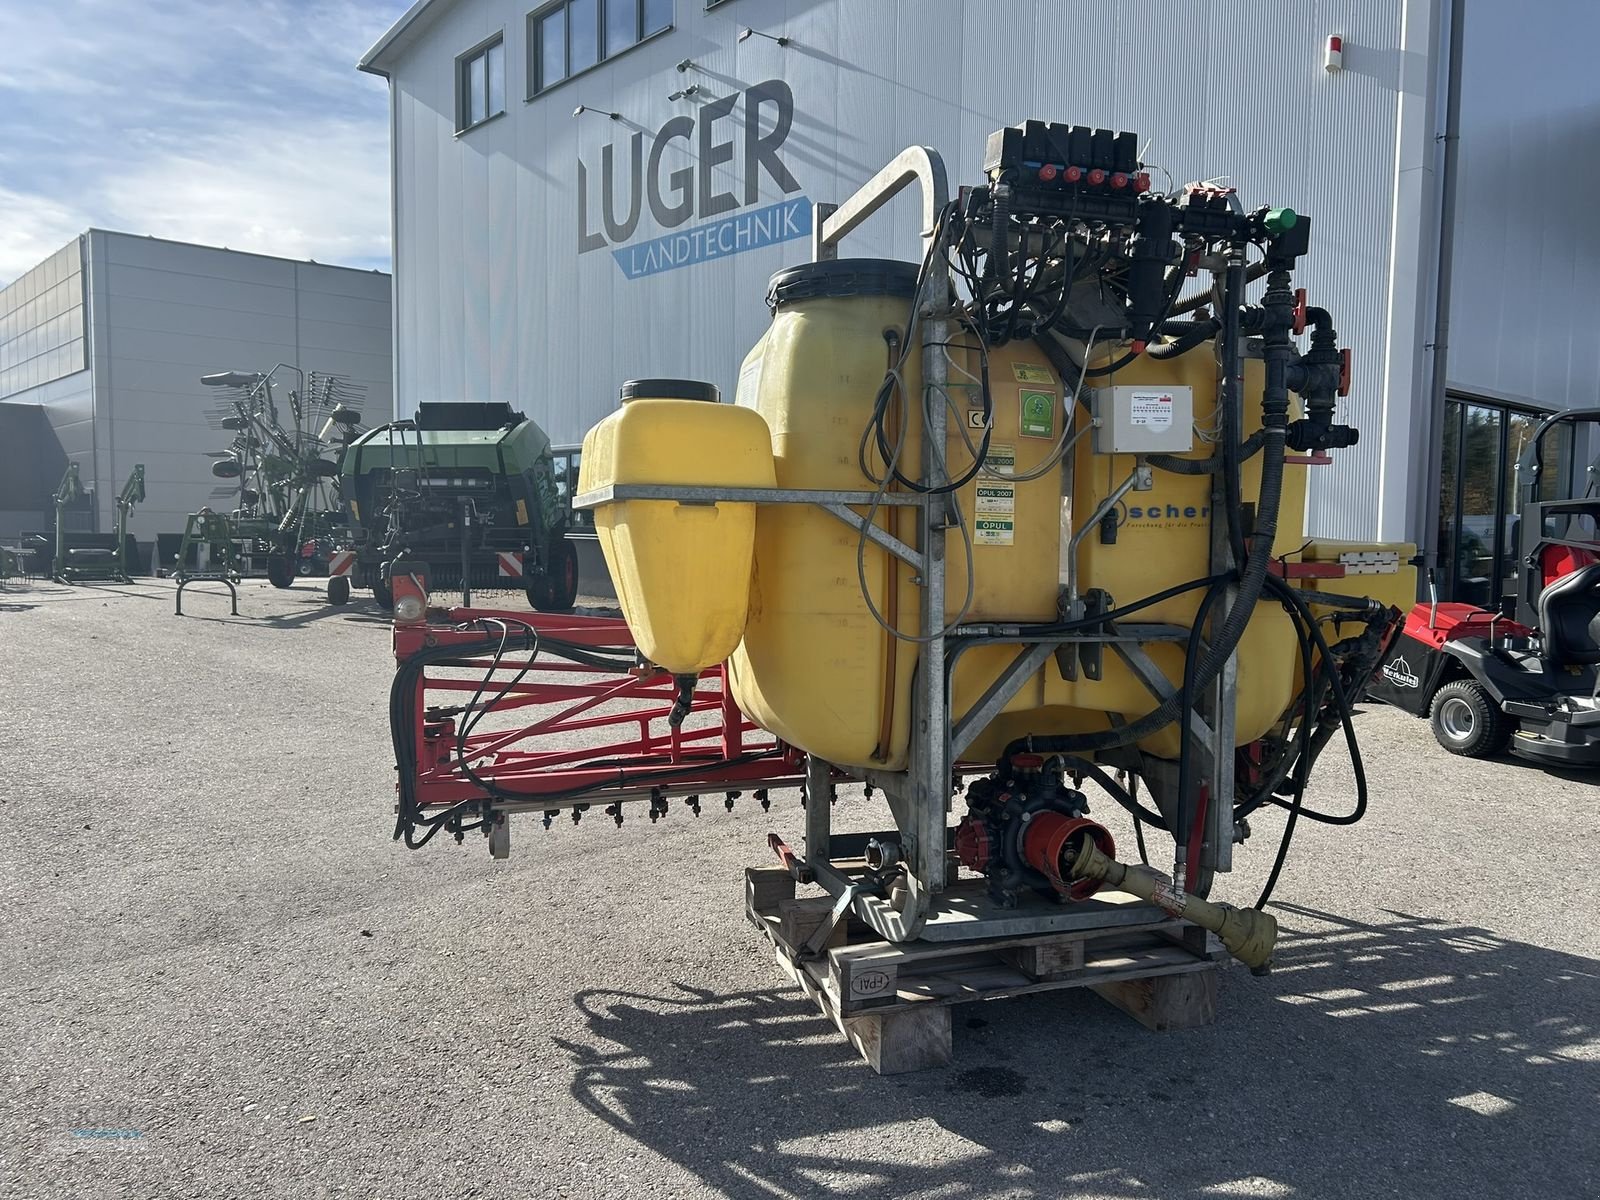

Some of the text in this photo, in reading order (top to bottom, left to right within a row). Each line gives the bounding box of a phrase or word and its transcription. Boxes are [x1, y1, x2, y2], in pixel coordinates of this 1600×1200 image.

[578, 79, 802, 255] LUGER
[631, 203, 801, 276] LANDTECHNIK
[978, 489, 1013, 498] ÖPUL 2007
[982, 521, 1007, 530] ÖPUL
